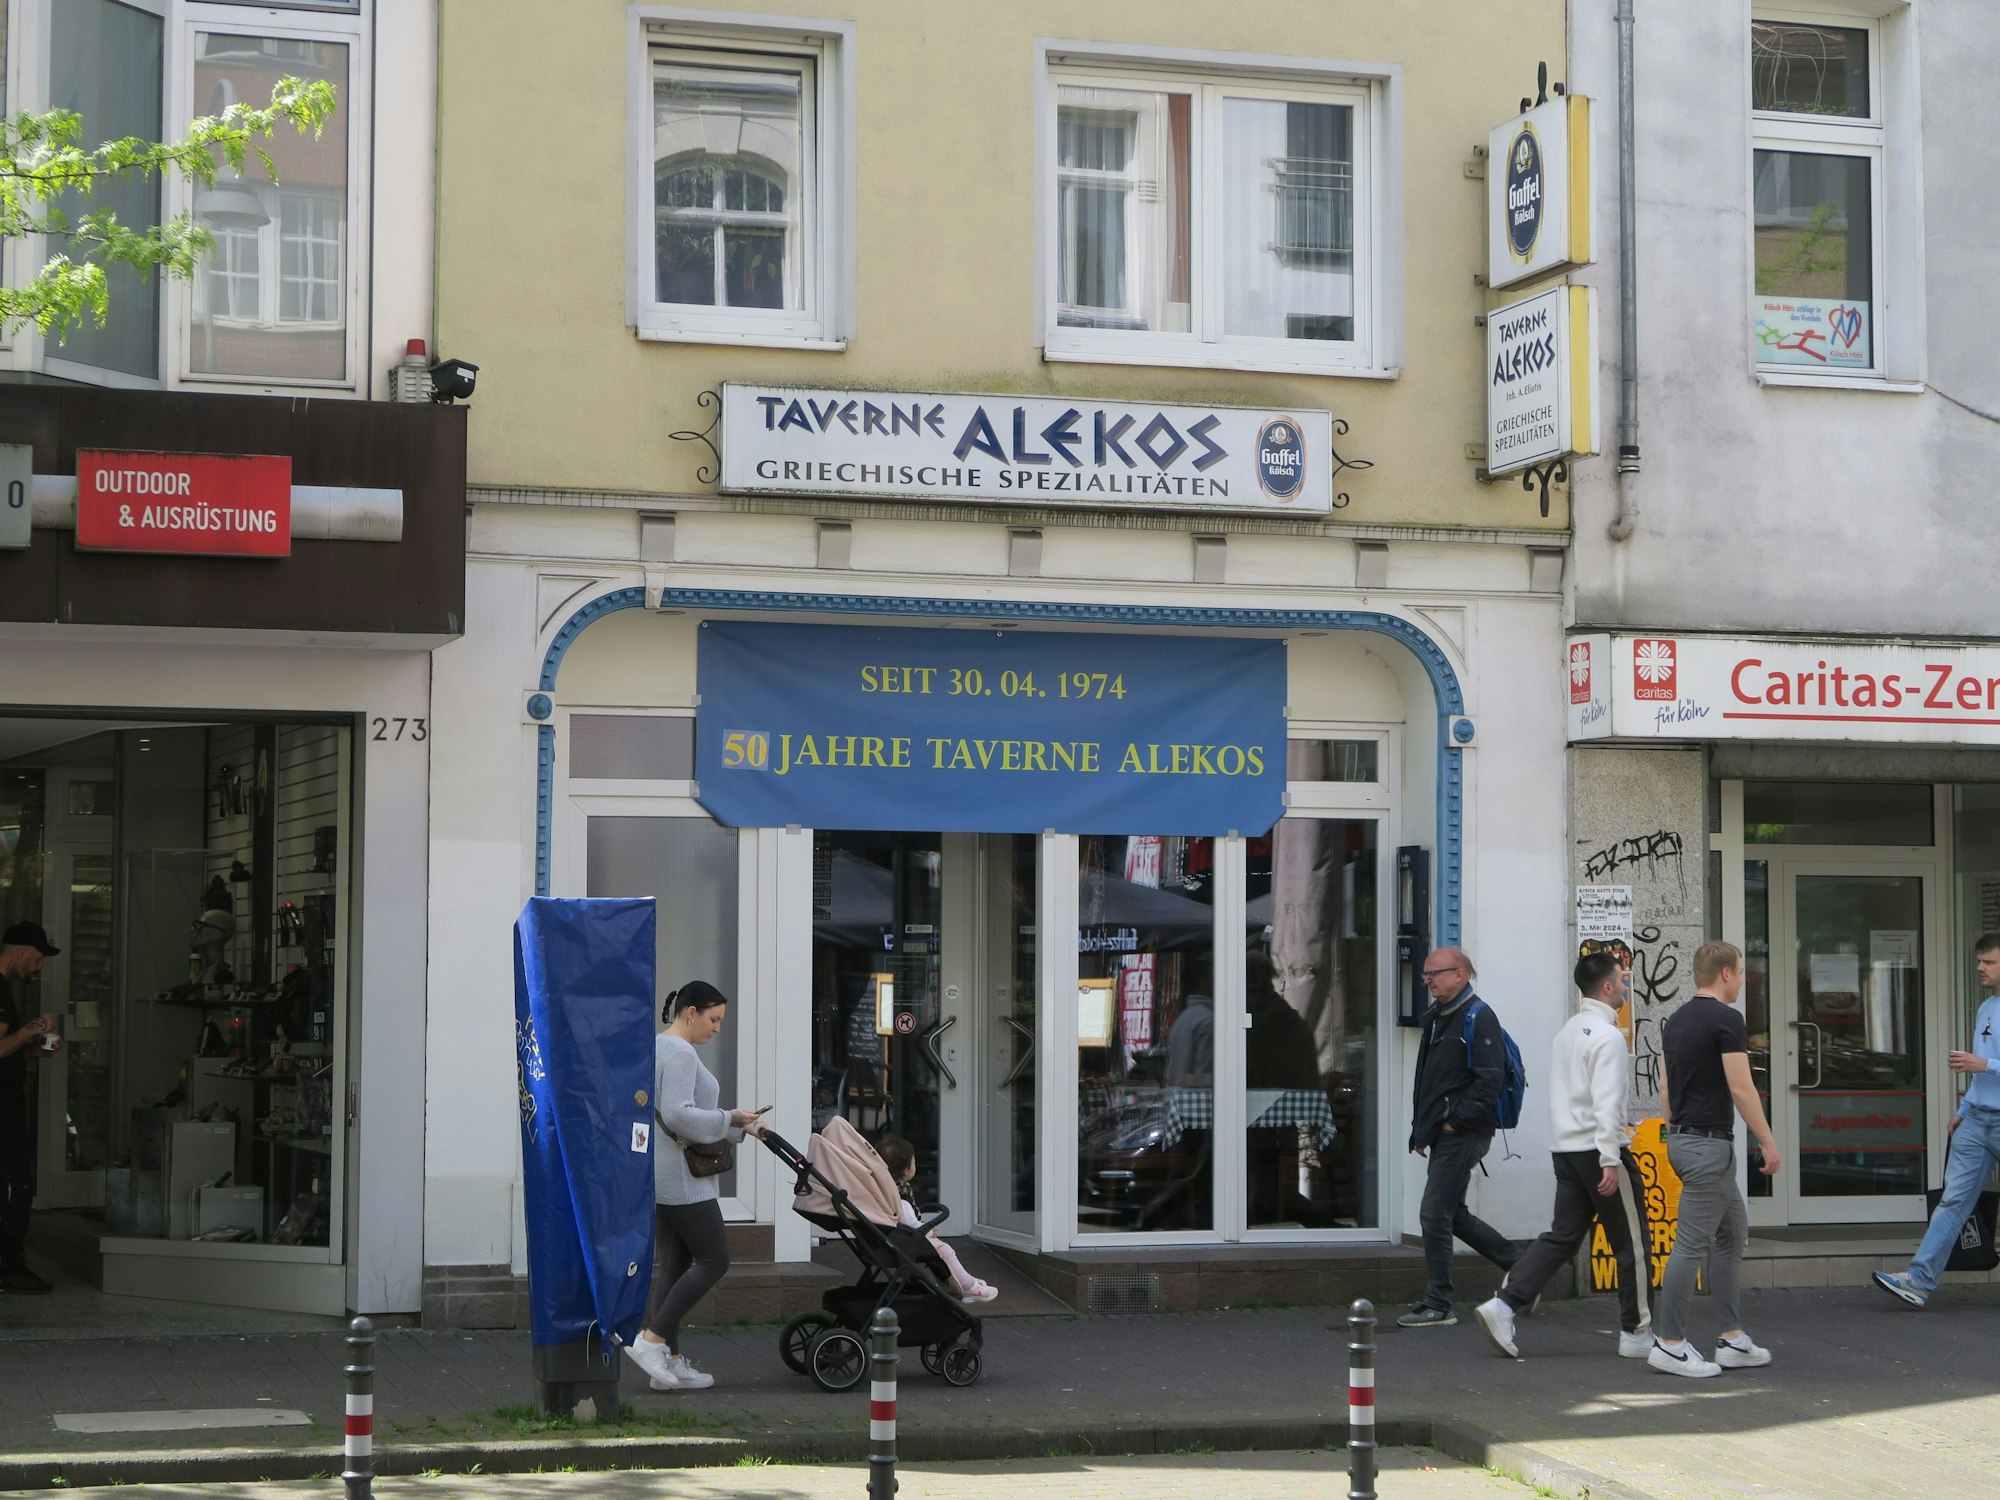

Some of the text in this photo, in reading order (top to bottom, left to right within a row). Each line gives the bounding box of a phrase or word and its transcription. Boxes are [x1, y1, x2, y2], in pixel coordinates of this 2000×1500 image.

[1509, 173, 1541, 210] Gaffel
[1514, 206, 1535, 226] Kölsch
[1499, 307, 1547, 344] TAVERNE
[1493, 332, 1556, 387] ALEKOS
[756, 396, 1232, 473] TAVERNE ALEKOS
[1496, 405, 1552, 434] GRIECHISCHE
[1495, 421, 1555, 453] SPEZIALITÄTEN
[1261, 448, 1302, 466] Gaffel
[1269, 466, 1295, 477] Kölsch
[95, 470, 191, 495] OUTDOOR
[756, 460, 981, 488] GRIECHISCHE
[999, 467, 1230, 497] SPEZIALITÄTEN
[118, 501, 277, 533] & AUSRÜSTUNG
[860, 664, 937, 695] SEIT
[1636, 687, 1673, 699] caritas
[1572, 691, 1590, 701] caritas
[372, 717, 427, 741] 273
[722, 732, 1265, 777] 50 JAHRE TAVERNE ALEKOS
